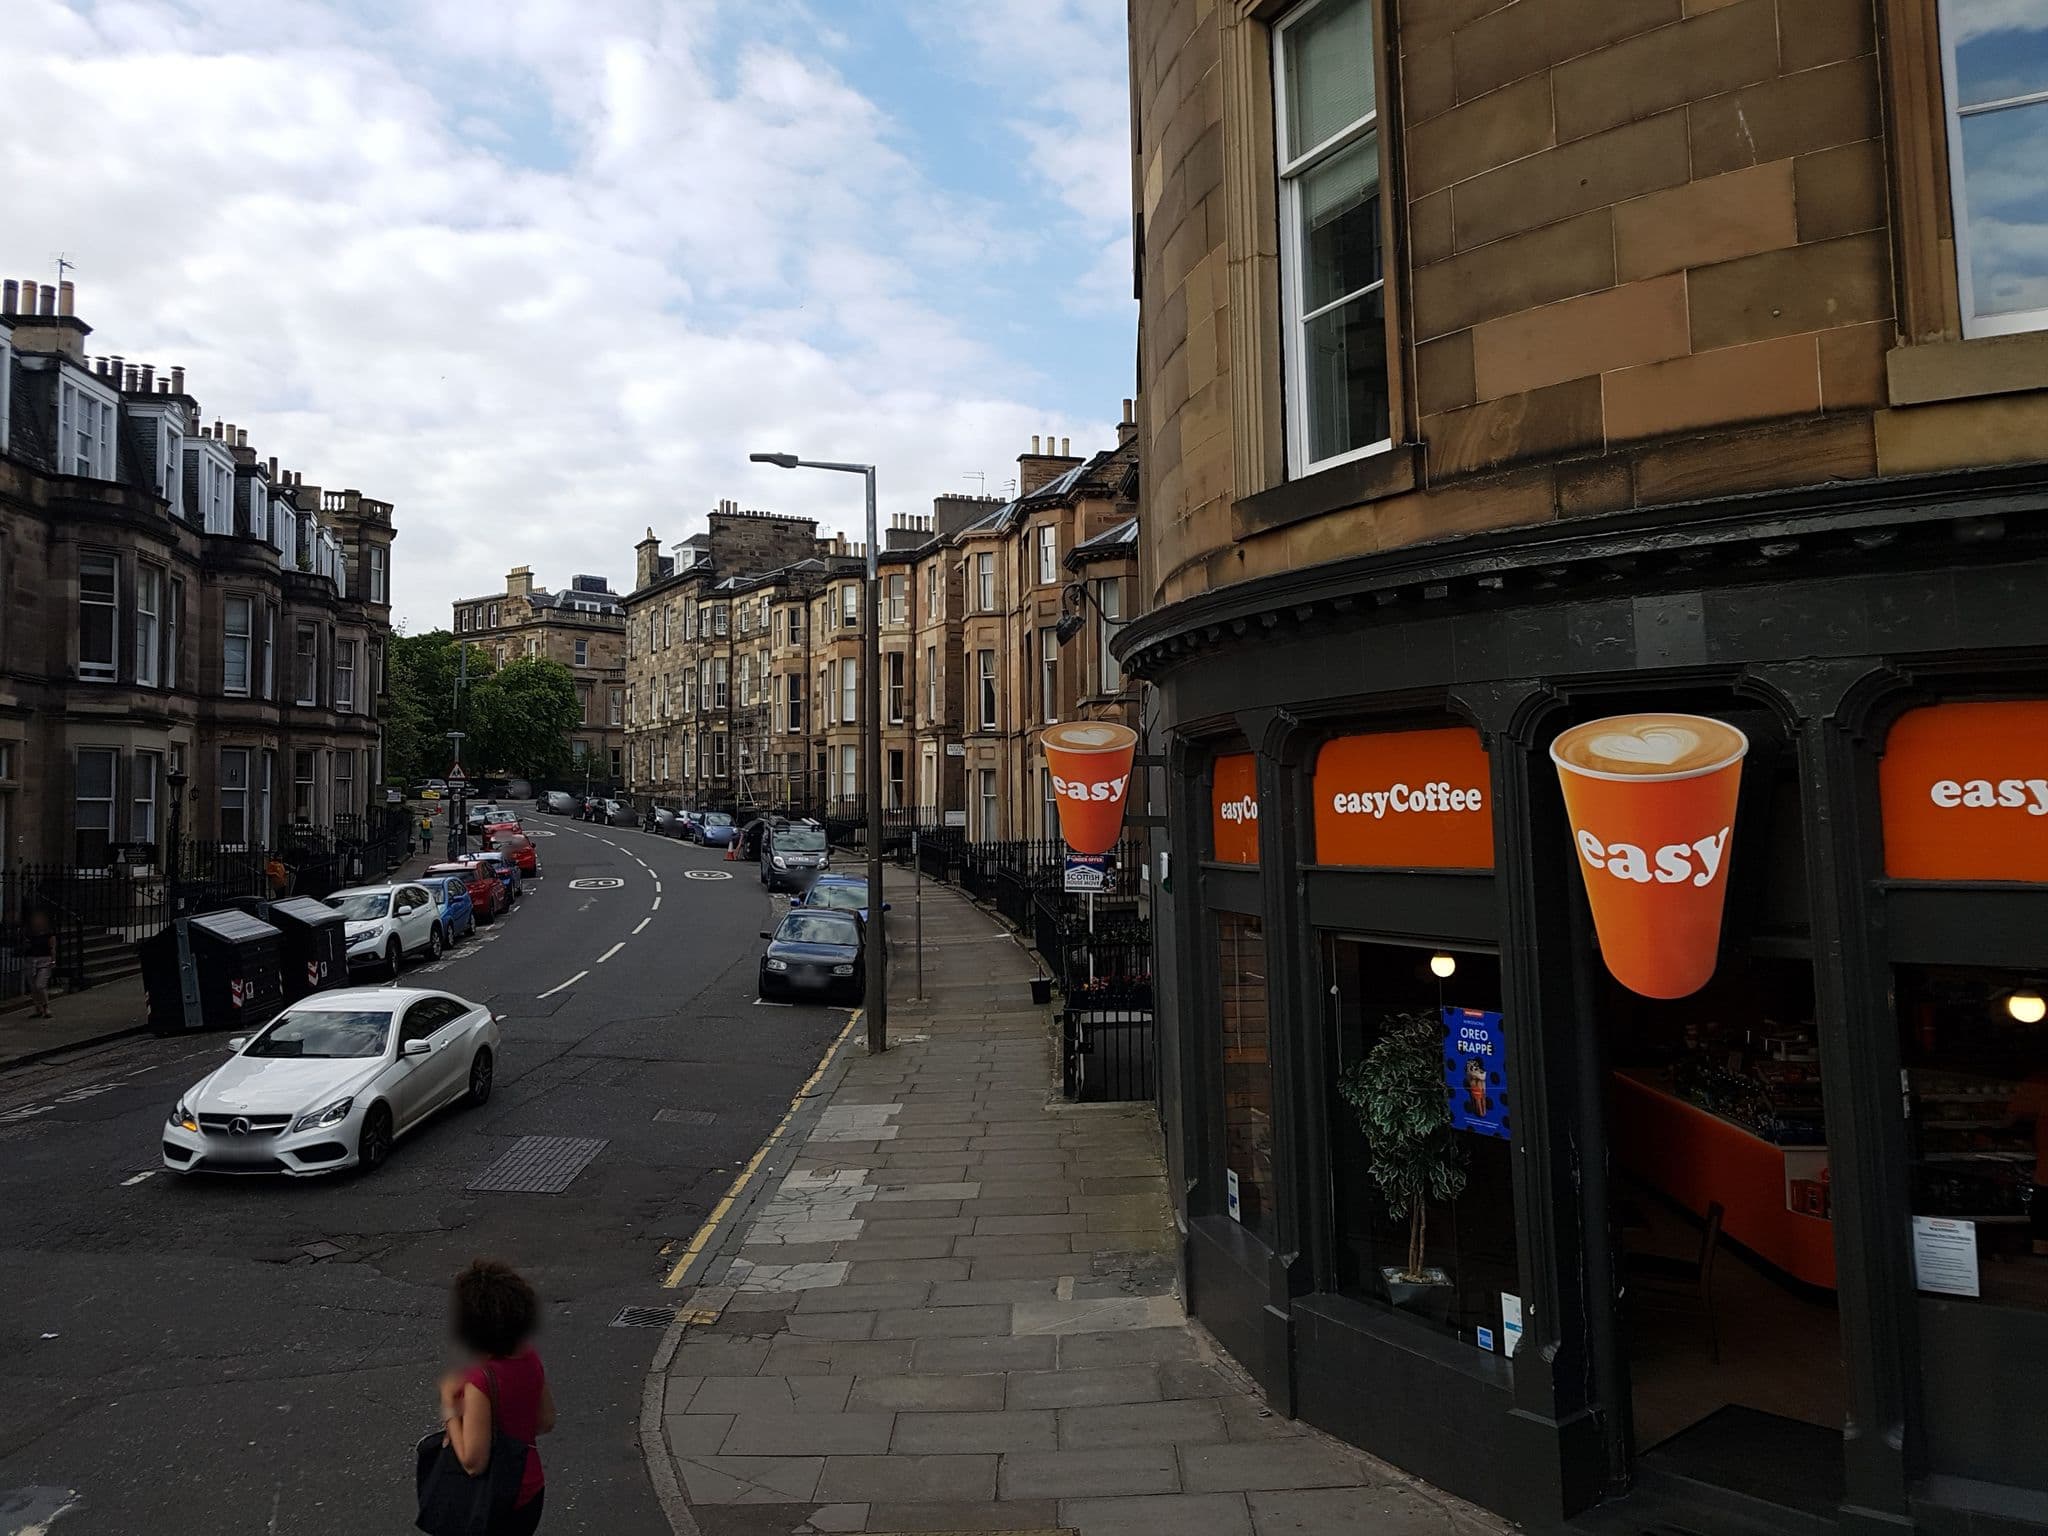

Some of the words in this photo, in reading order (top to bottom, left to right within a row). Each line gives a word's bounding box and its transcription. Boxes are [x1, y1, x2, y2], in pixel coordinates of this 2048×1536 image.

[1053, 774, 1128, 802] easy
[1333, 782, 1482, 819] easyCoffee
[1576, 826, 1730, 888] easy
[1457, 1040, 1493, 1056] FRAPPÉ
[1460, 1027, 1489, 1041] OREO
